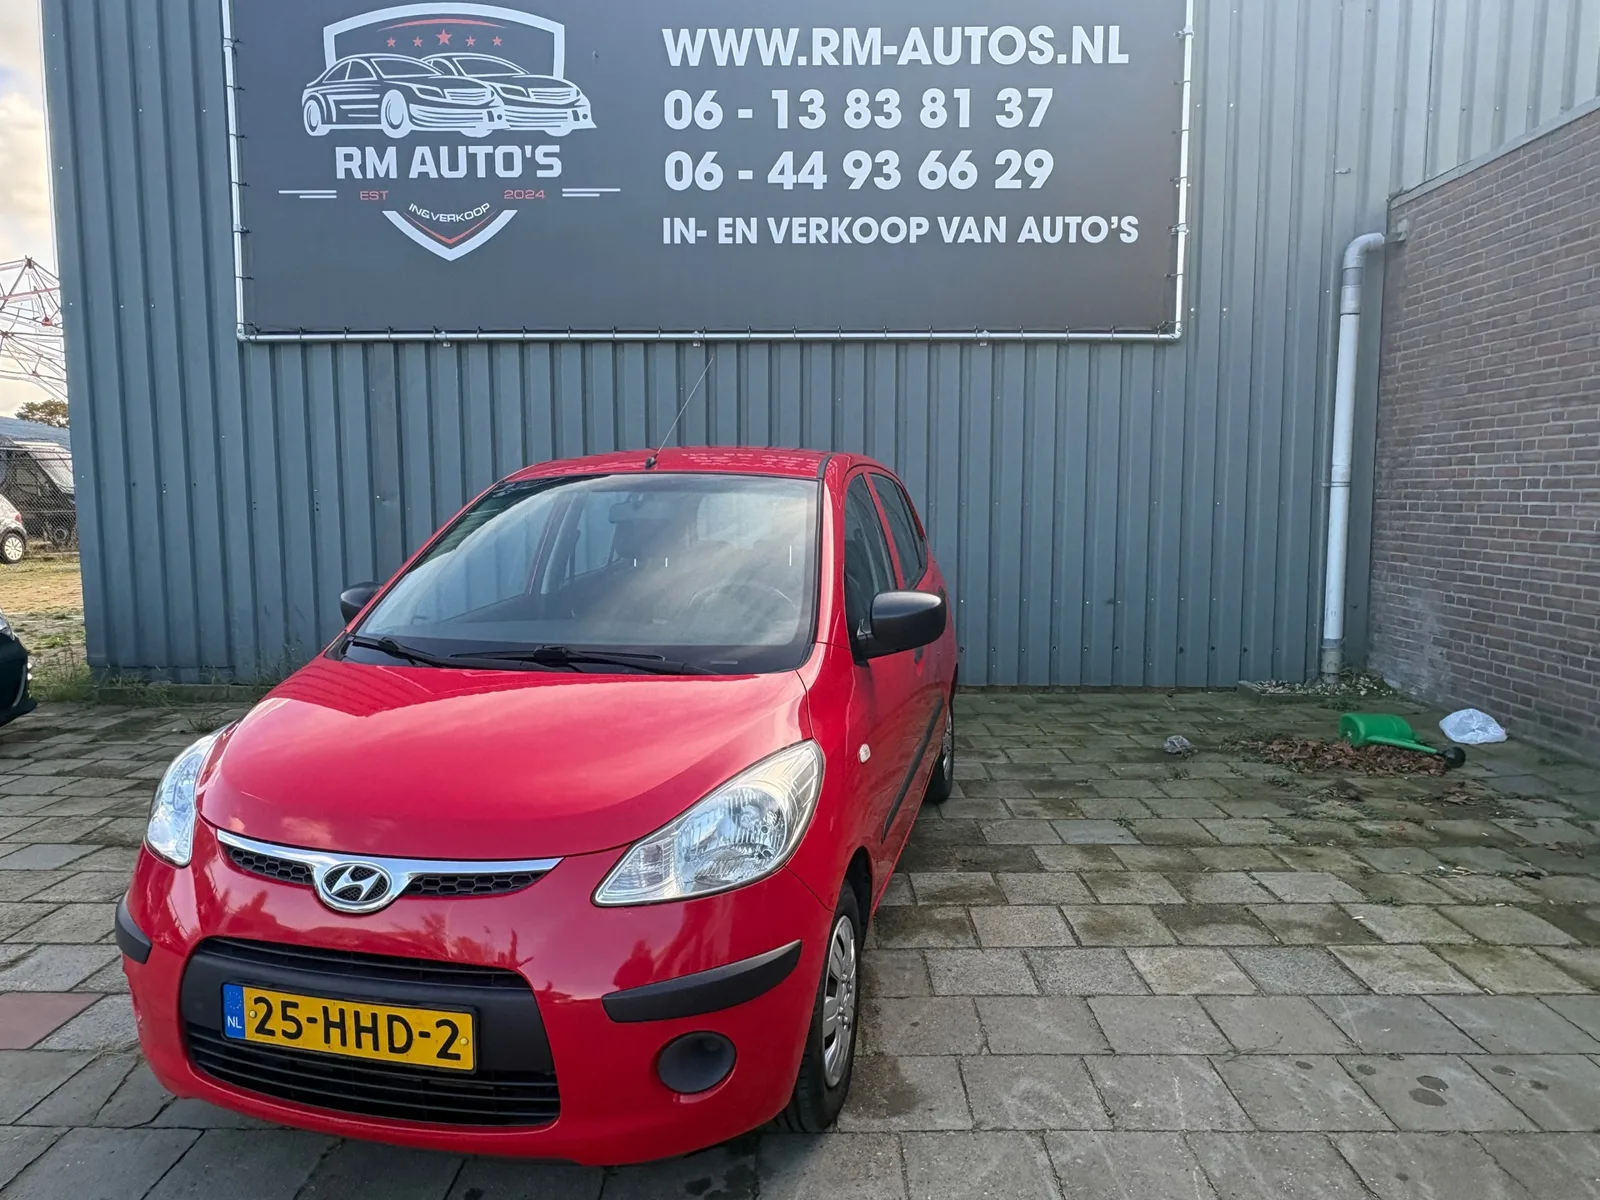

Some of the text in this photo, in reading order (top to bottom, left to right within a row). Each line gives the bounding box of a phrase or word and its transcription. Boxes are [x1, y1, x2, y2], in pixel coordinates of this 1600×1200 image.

[662, 25, 1129, 66] WWW.RM-AUTOS.NL
[663, 89, 724, 130] 06
[771, 89, 827, 129] 13
[844, 88, 902, 129] 83
[920, 88, 970, 128] 81
[995, 88, 1053, 128] 37
[335, 145, 562, 179] RM AUTO'S
[664, 150, 724, 191] 06
[767, 150, 827, 190] 44
[843, 150, 902, 190] 93
[918, 150, 978, 190] 66
[994, 149, 1053, 189] 29
[359, 189, 545, 200] EST 2024
[662, 215, 1139, 244] IN- EN VERKOOP VAN AUTO’S
[227, 1015, 242, 1030] NL
[253, 996, 461, 1061] 25-HHD-2
